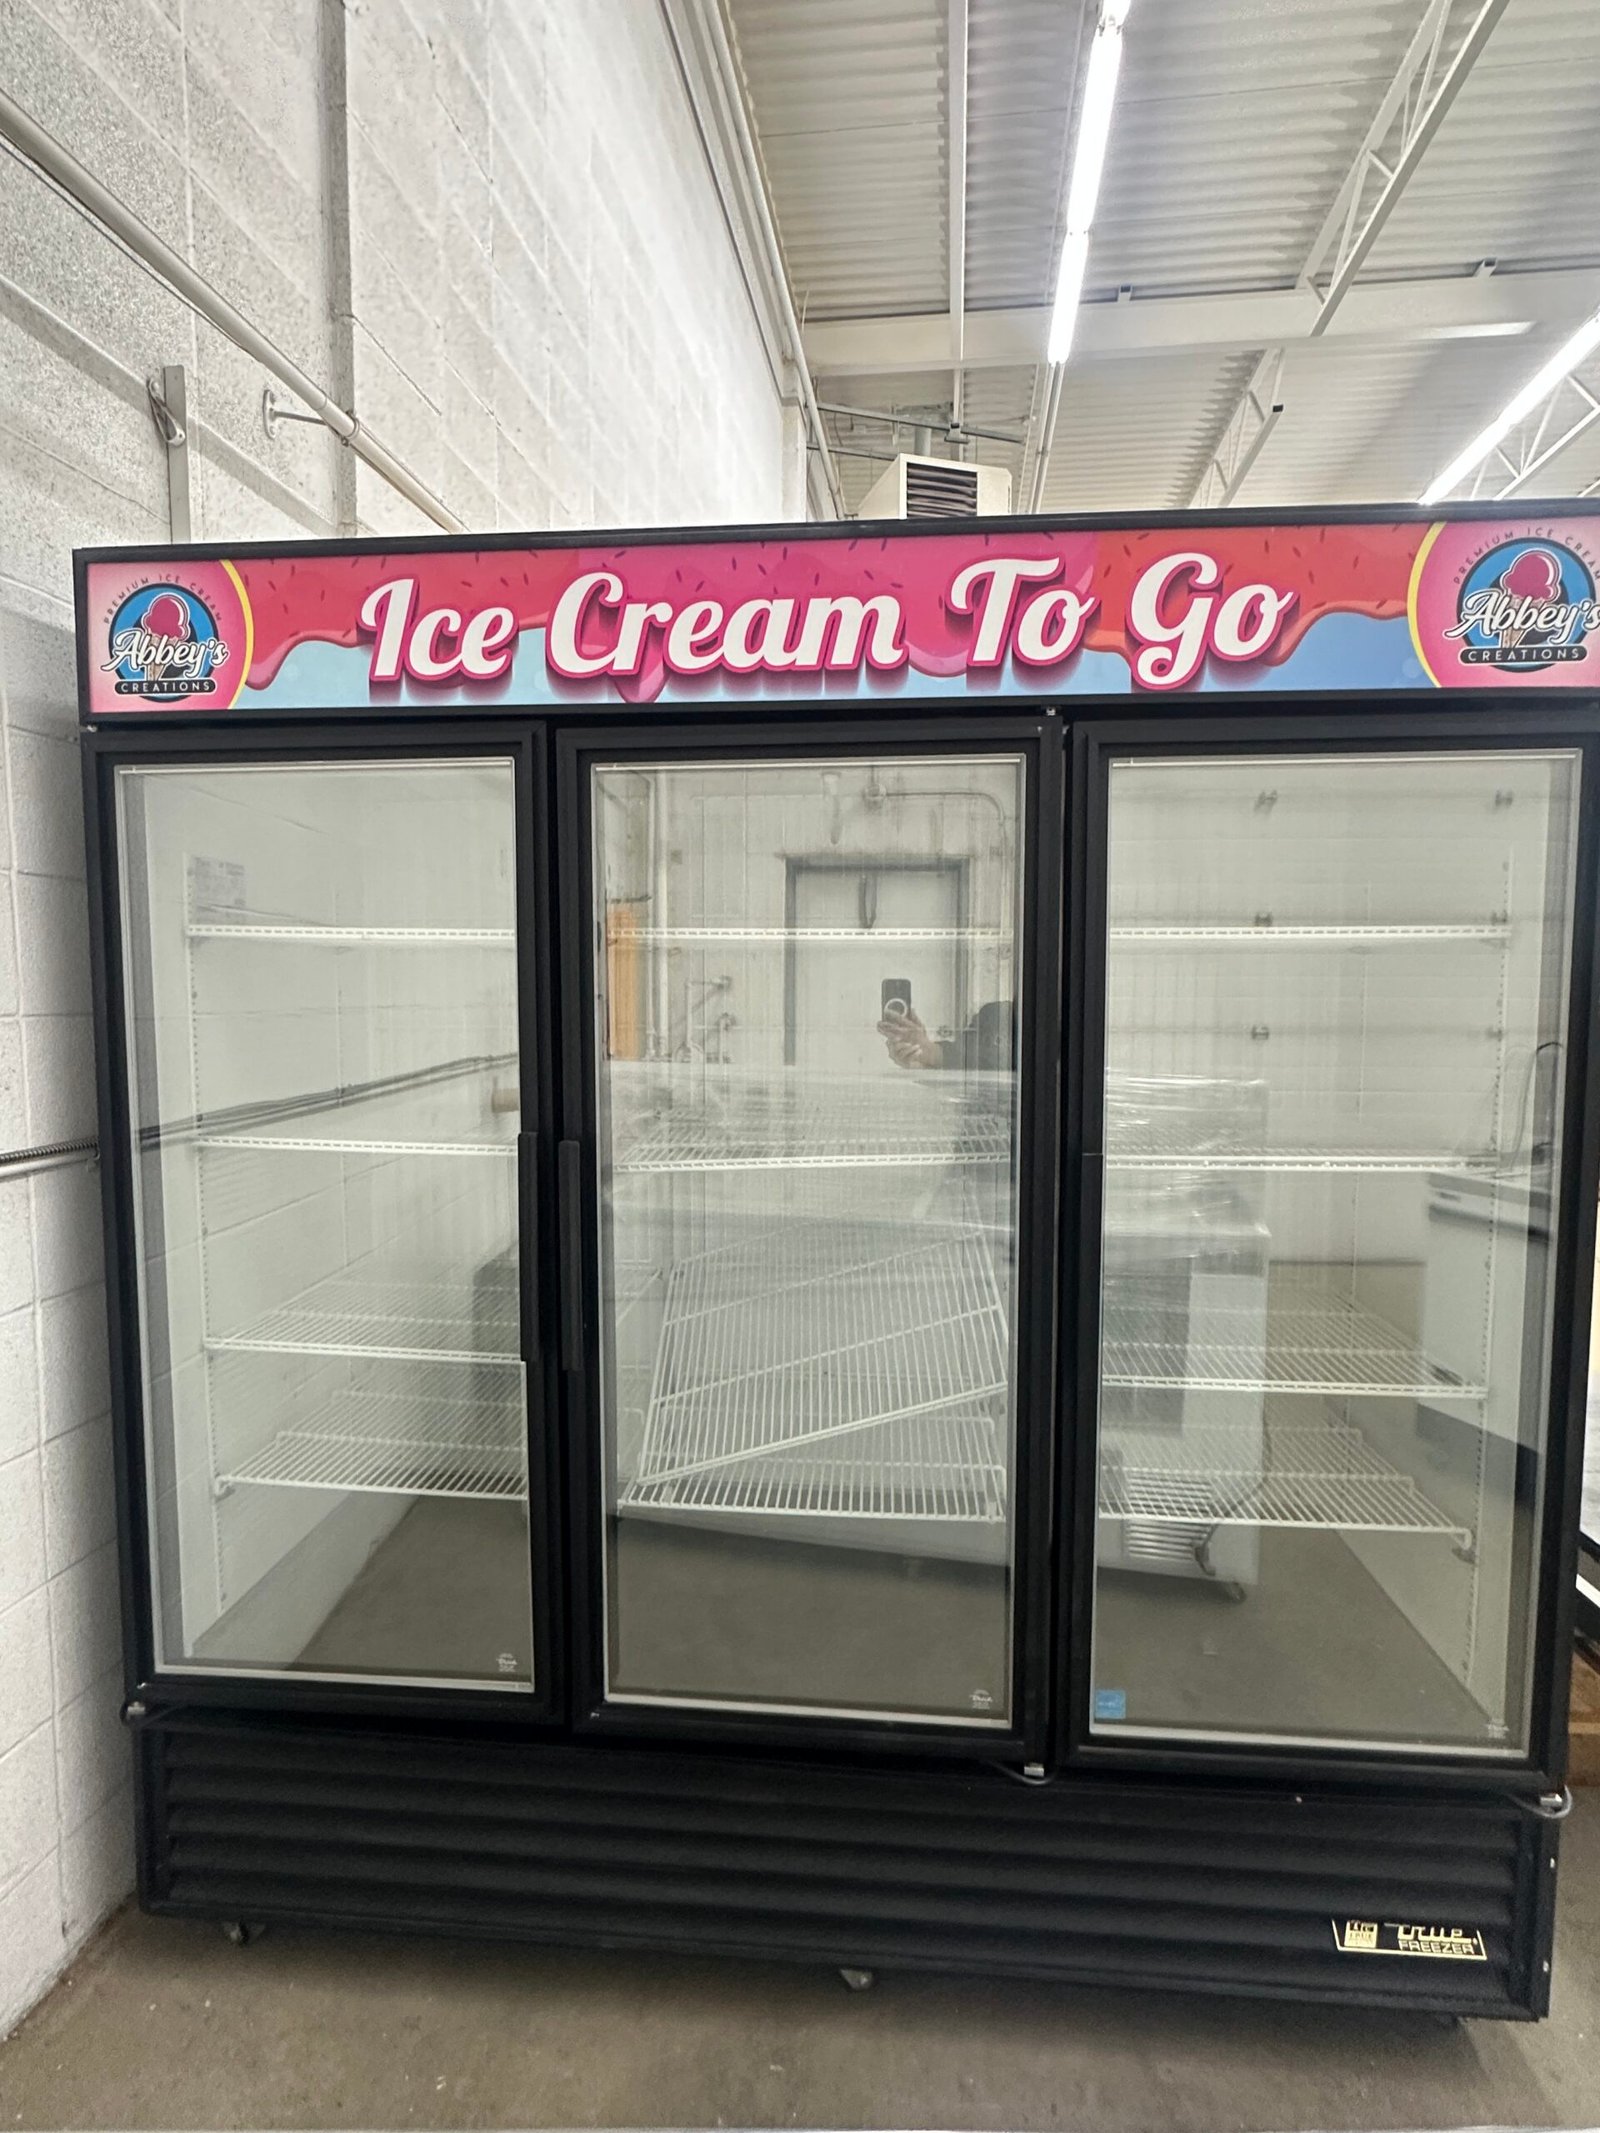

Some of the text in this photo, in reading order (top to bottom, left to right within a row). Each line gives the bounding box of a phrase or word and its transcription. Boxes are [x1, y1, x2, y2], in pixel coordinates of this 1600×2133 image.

[1453, 526, 1600, 585] PREMIUM ICE CREAM
[103, 573, 222, 624] PREMIUM ICE CREAM
[360, 551, 1295, 685] Ice Cream To Go
[1444, 588, 1600, 645] Abbey's
[101, 629, 229, 679] Abbey's
[1467, 647, 1580, 662] CREATIONS
[121, 681, 210, 693] CREATIONS
[1398, 1940, 1475, 1955] FREEZER
